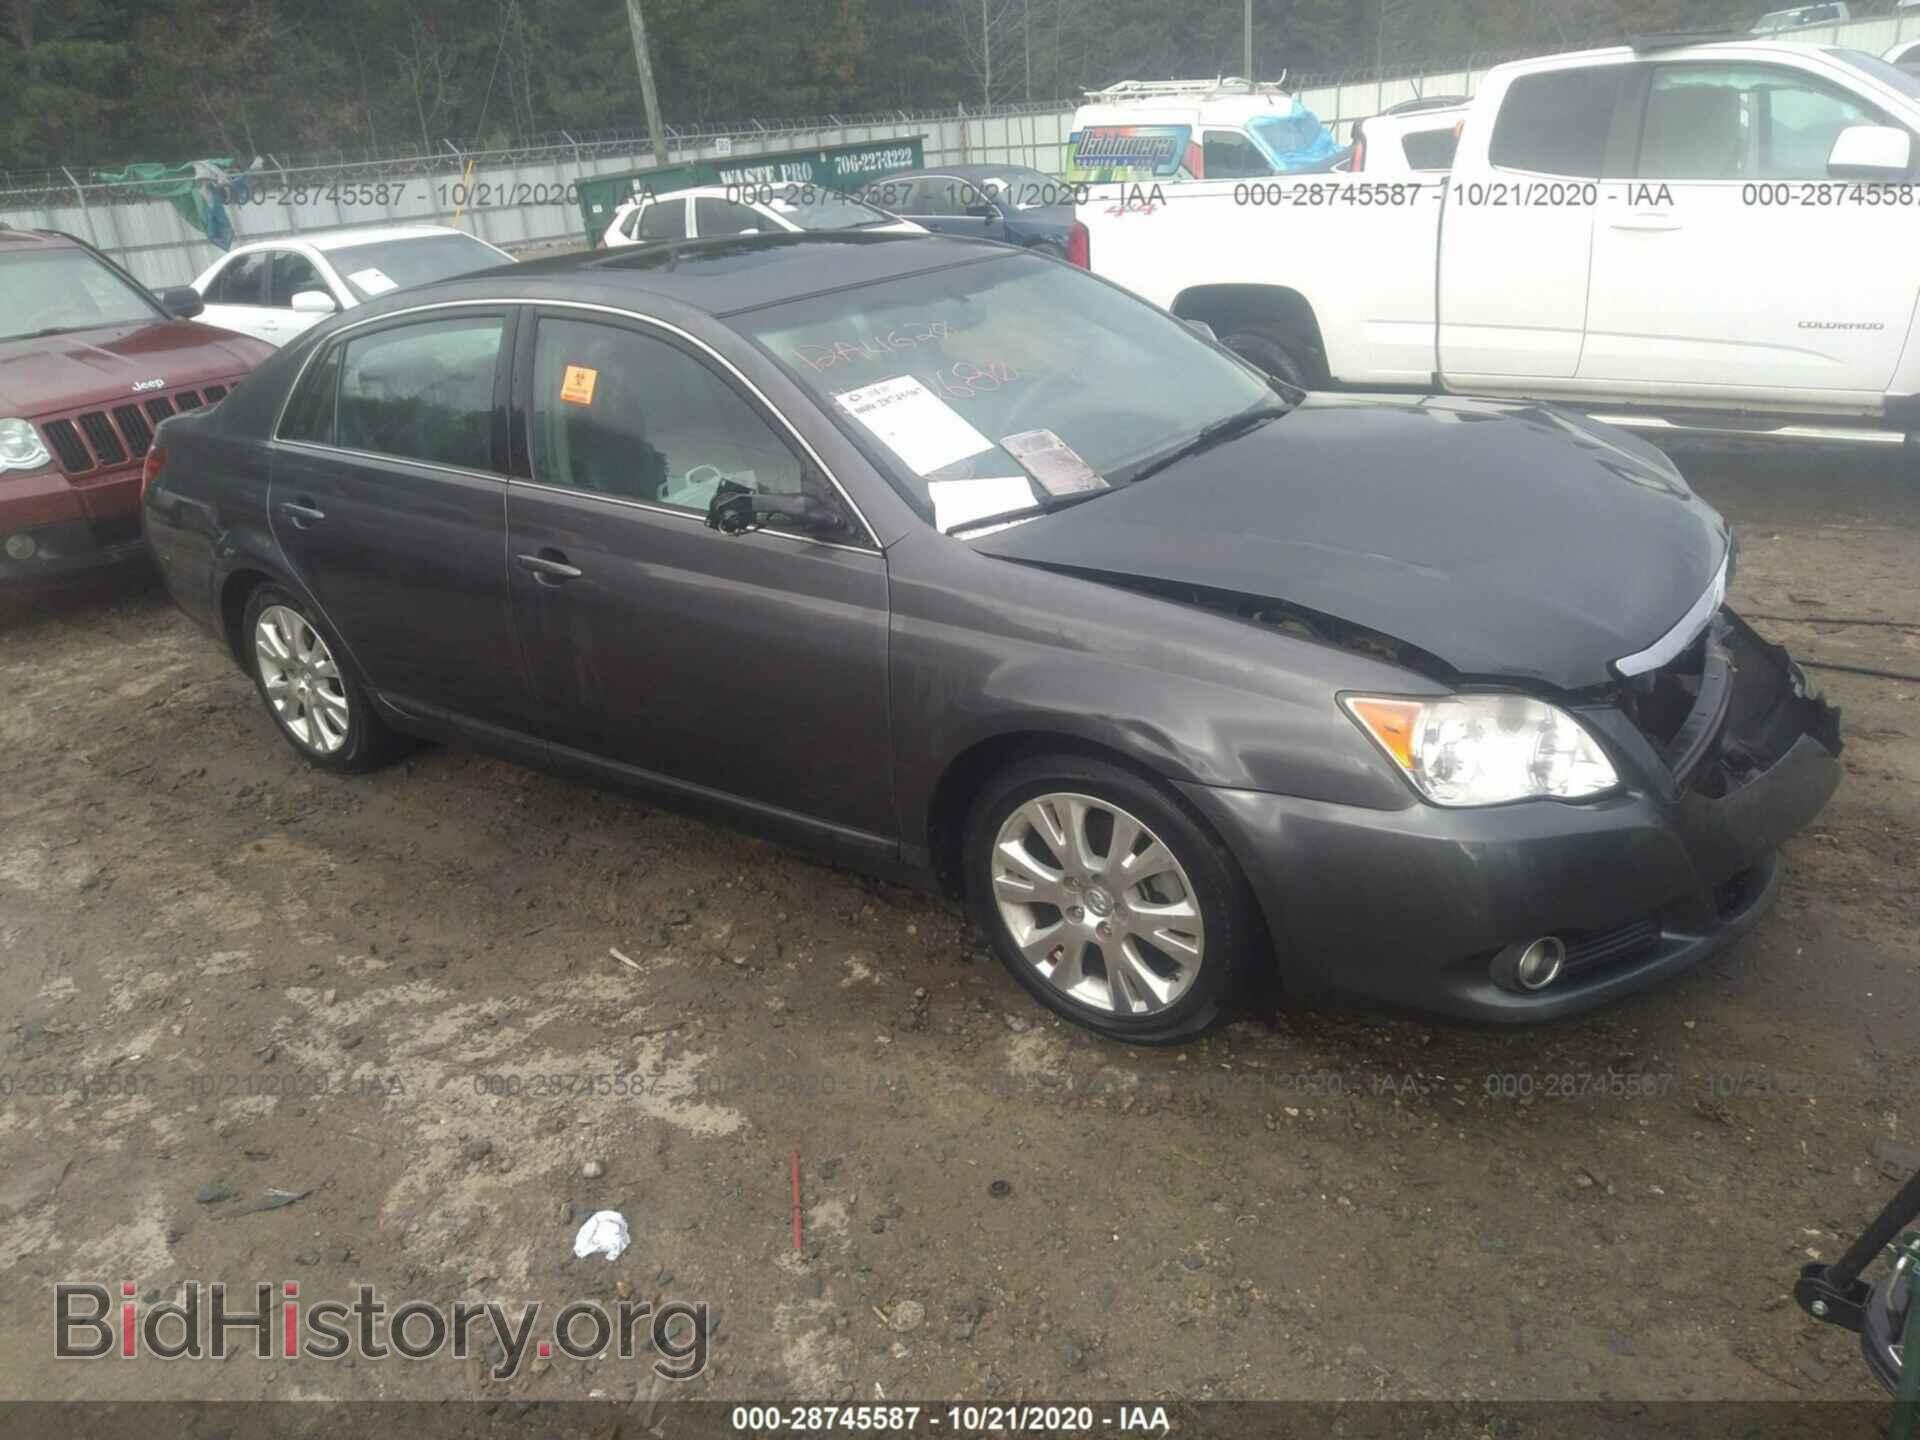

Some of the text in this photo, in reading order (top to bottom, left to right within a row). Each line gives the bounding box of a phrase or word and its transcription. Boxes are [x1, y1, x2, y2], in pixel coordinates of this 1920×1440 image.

[834, 147, 913, 175] 706-227-3222
[719, 162, 813, 184] WASTE PRO
[1797, 320, 1885, 331] COLORADO
[131, 378, 165, 392] Jeep
